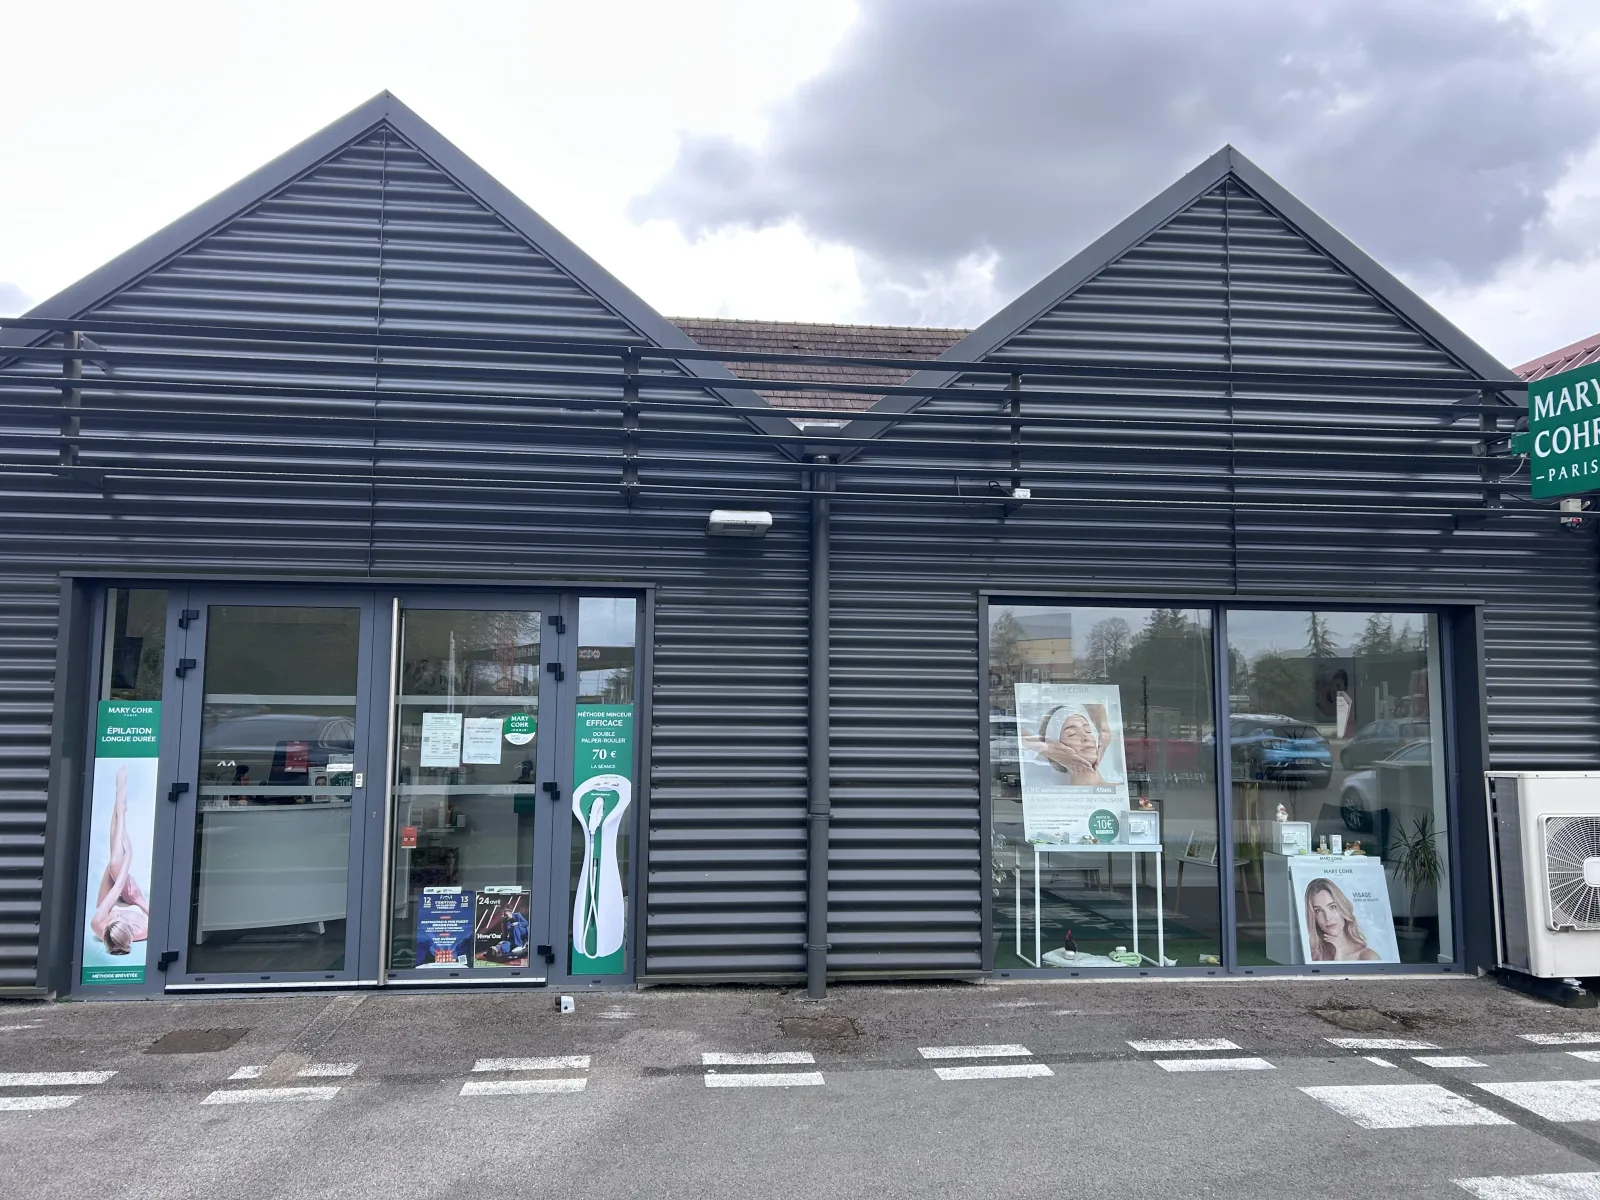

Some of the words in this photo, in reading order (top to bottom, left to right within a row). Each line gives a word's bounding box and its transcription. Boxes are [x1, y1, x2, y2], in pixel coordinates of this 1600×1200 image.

[1534, 378, 1600, 422] MARY
[107, 726, 152, 734] ÉPILATION
[592, 748, 607, 760] 70
[610, 750, 617, 758] €
[423, 896, 432, 904] 12
[460, 895, 469, 903] 13
[478, 897, 489, 905] 24
